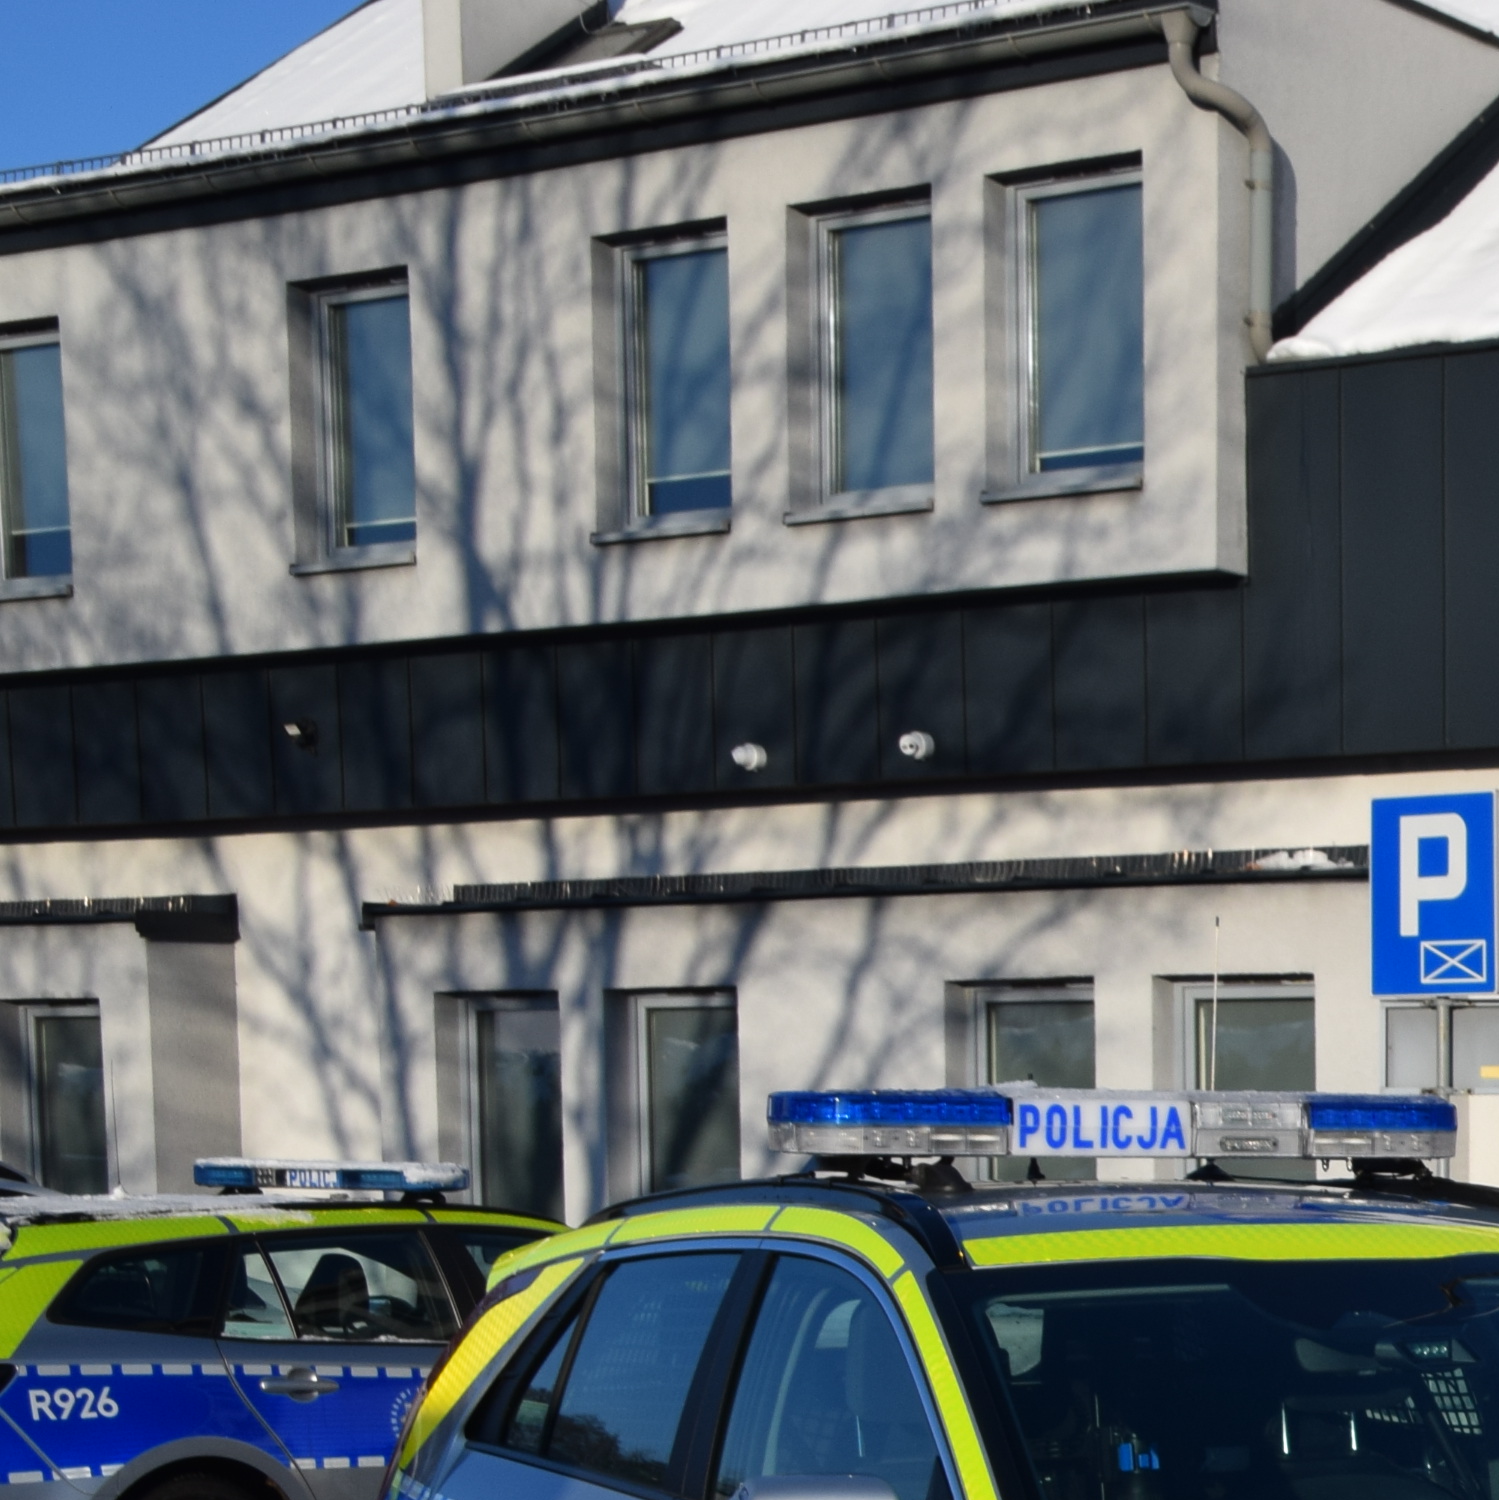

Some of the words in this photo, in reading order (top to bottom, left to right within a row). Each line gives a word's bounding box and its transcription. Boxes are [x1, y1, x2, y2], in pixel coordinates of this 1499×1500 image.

[1400, 813, 1467, 937] P
[1018, 1103, 1186, 1150] POLICJA
[289, 1169, 337, 1188] POLIC
[28, 1386, 119, 1421] R926
